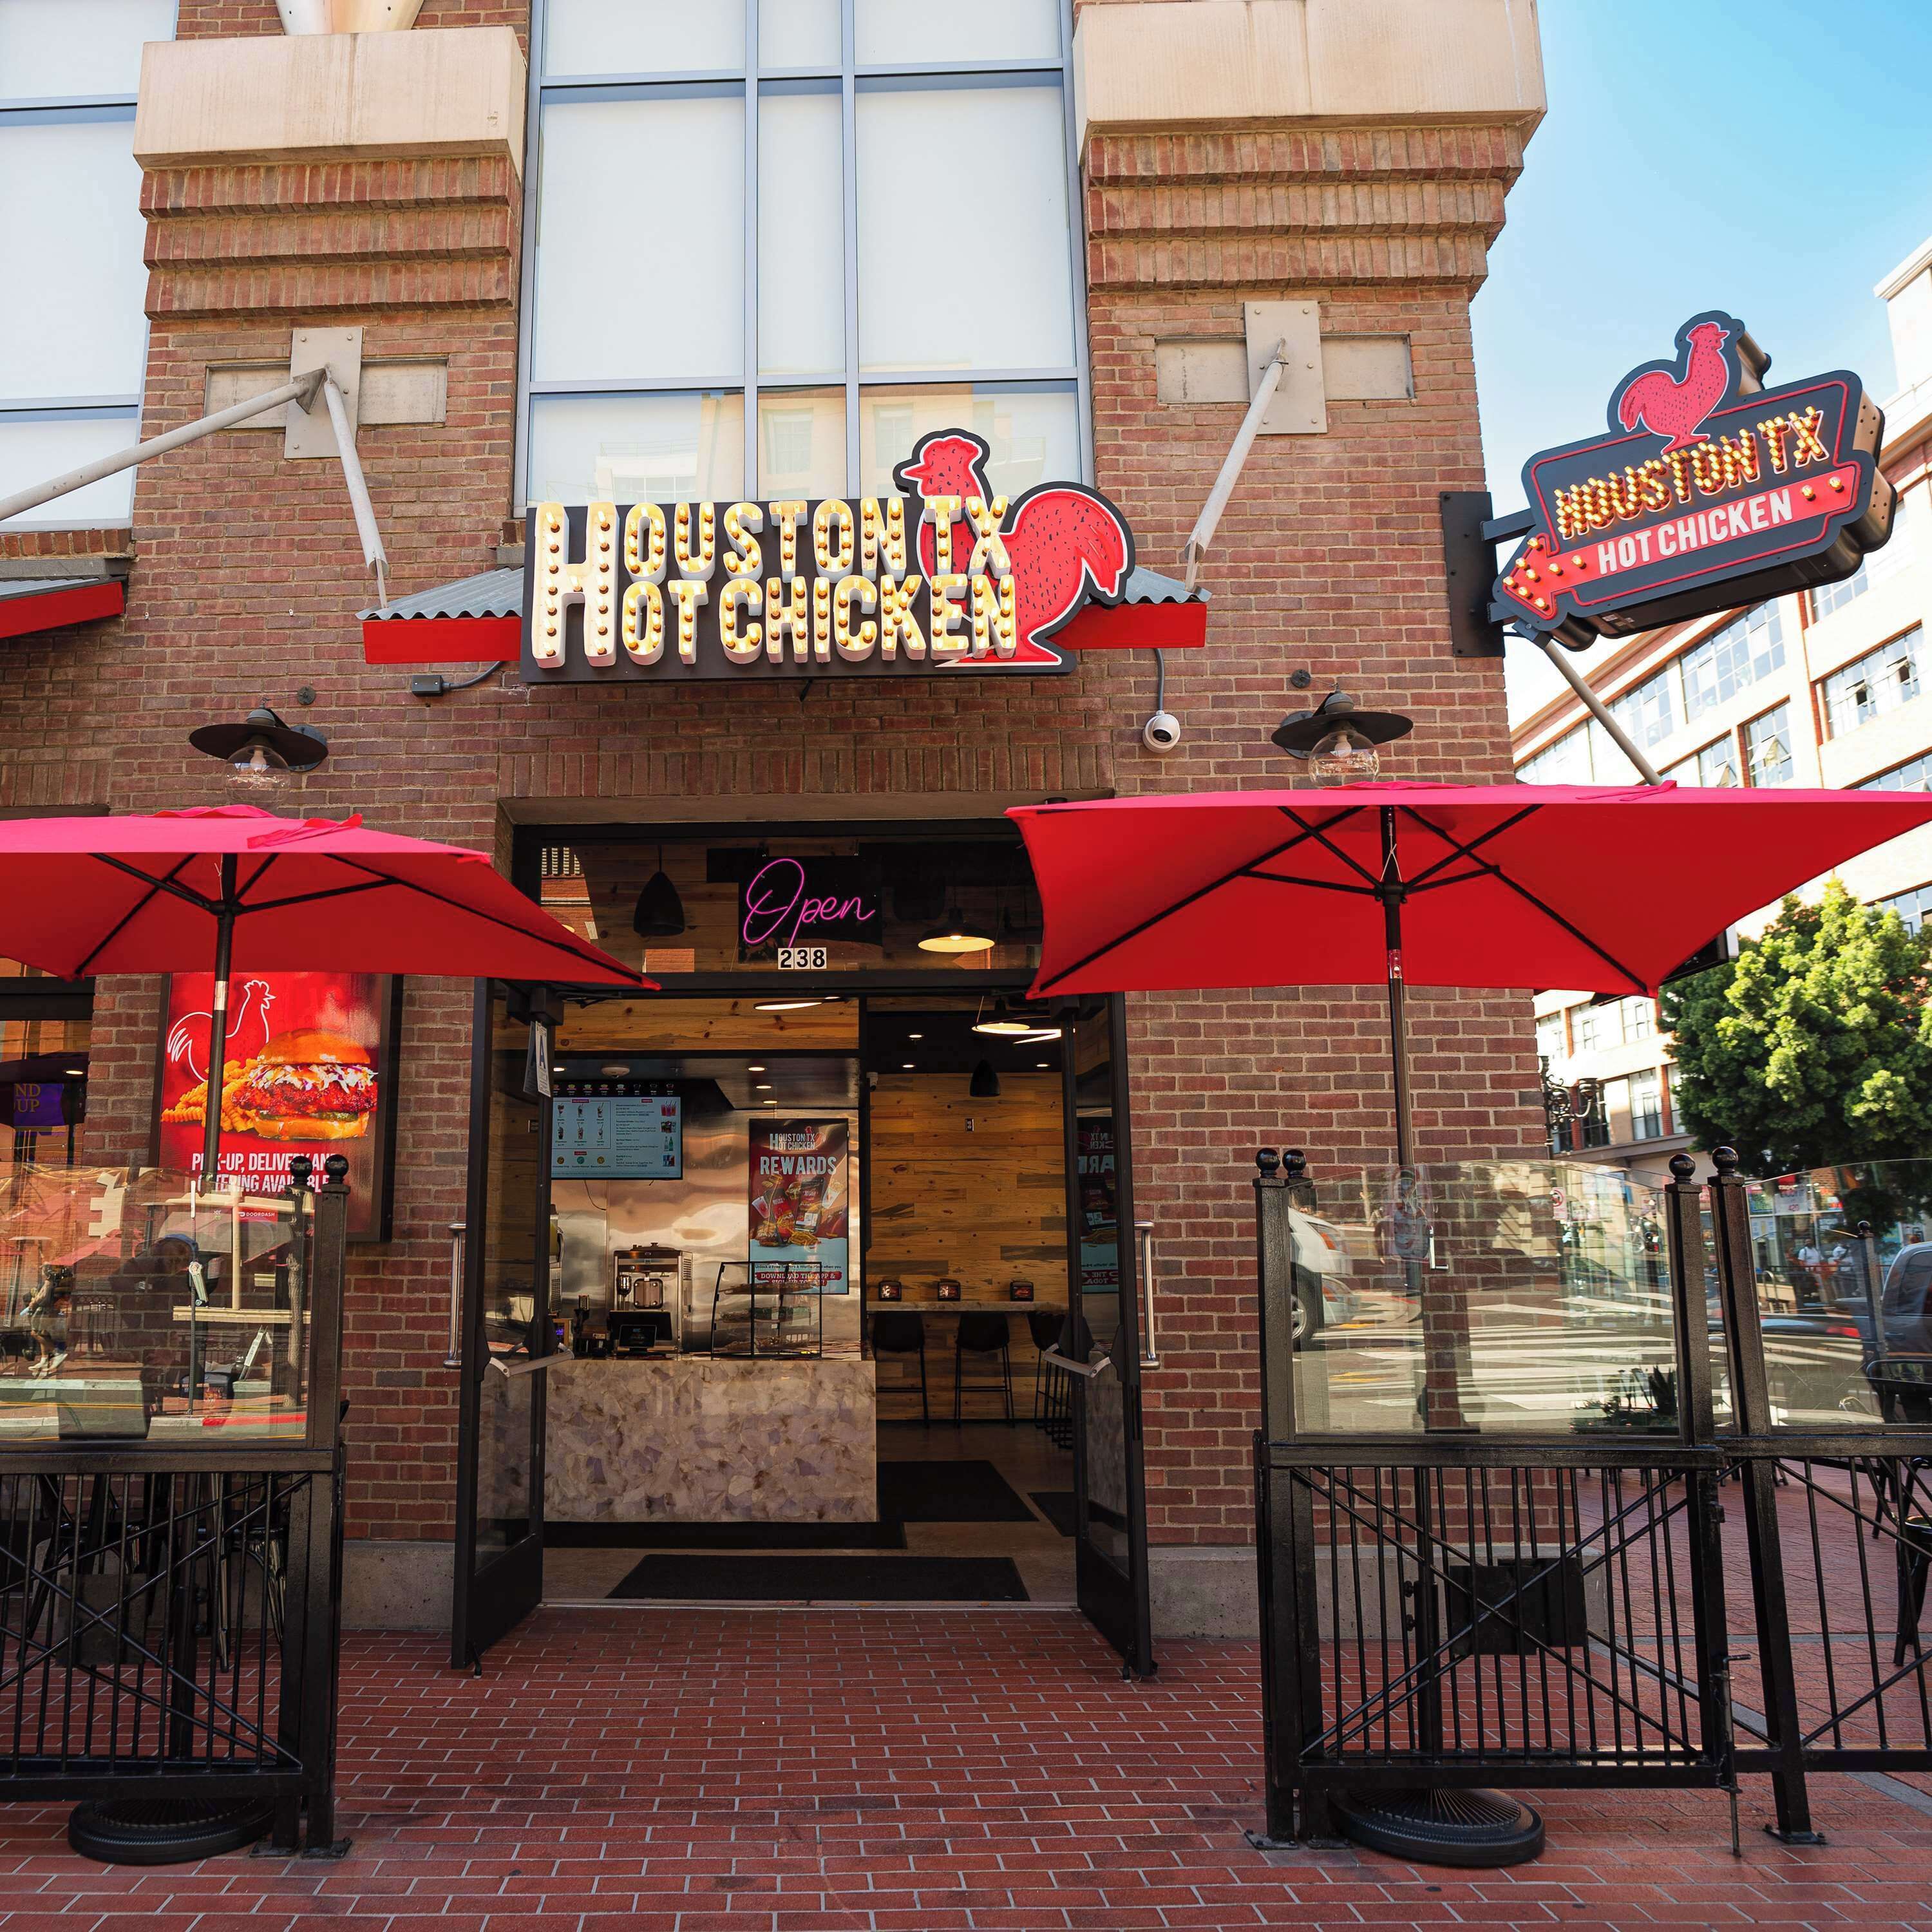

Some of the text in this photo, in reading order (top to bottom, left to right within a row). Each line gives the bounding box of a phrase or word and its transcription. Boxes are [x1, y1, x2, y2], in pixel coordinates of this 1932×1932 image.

[1554, 406, 1829, 540] HOUSTON TX
[922, 494, 1010, 580] TX
[1597, 489, 1794, 575] HOT CHICKEN
[719, 573, 1017, 665] CHICKEN
[743, 858, 876, 948] Open
[780, 949, 826, 969] 238
[192, 1153, 245, 1173] PIK-UP,
[249, 1153, 310, 1171] DELIVE
[788, 1142, 816, 1150] CHICKEN
[806, 1133, 815, 1142] TX
[760, 1156, 837, 1175] REWARDS
